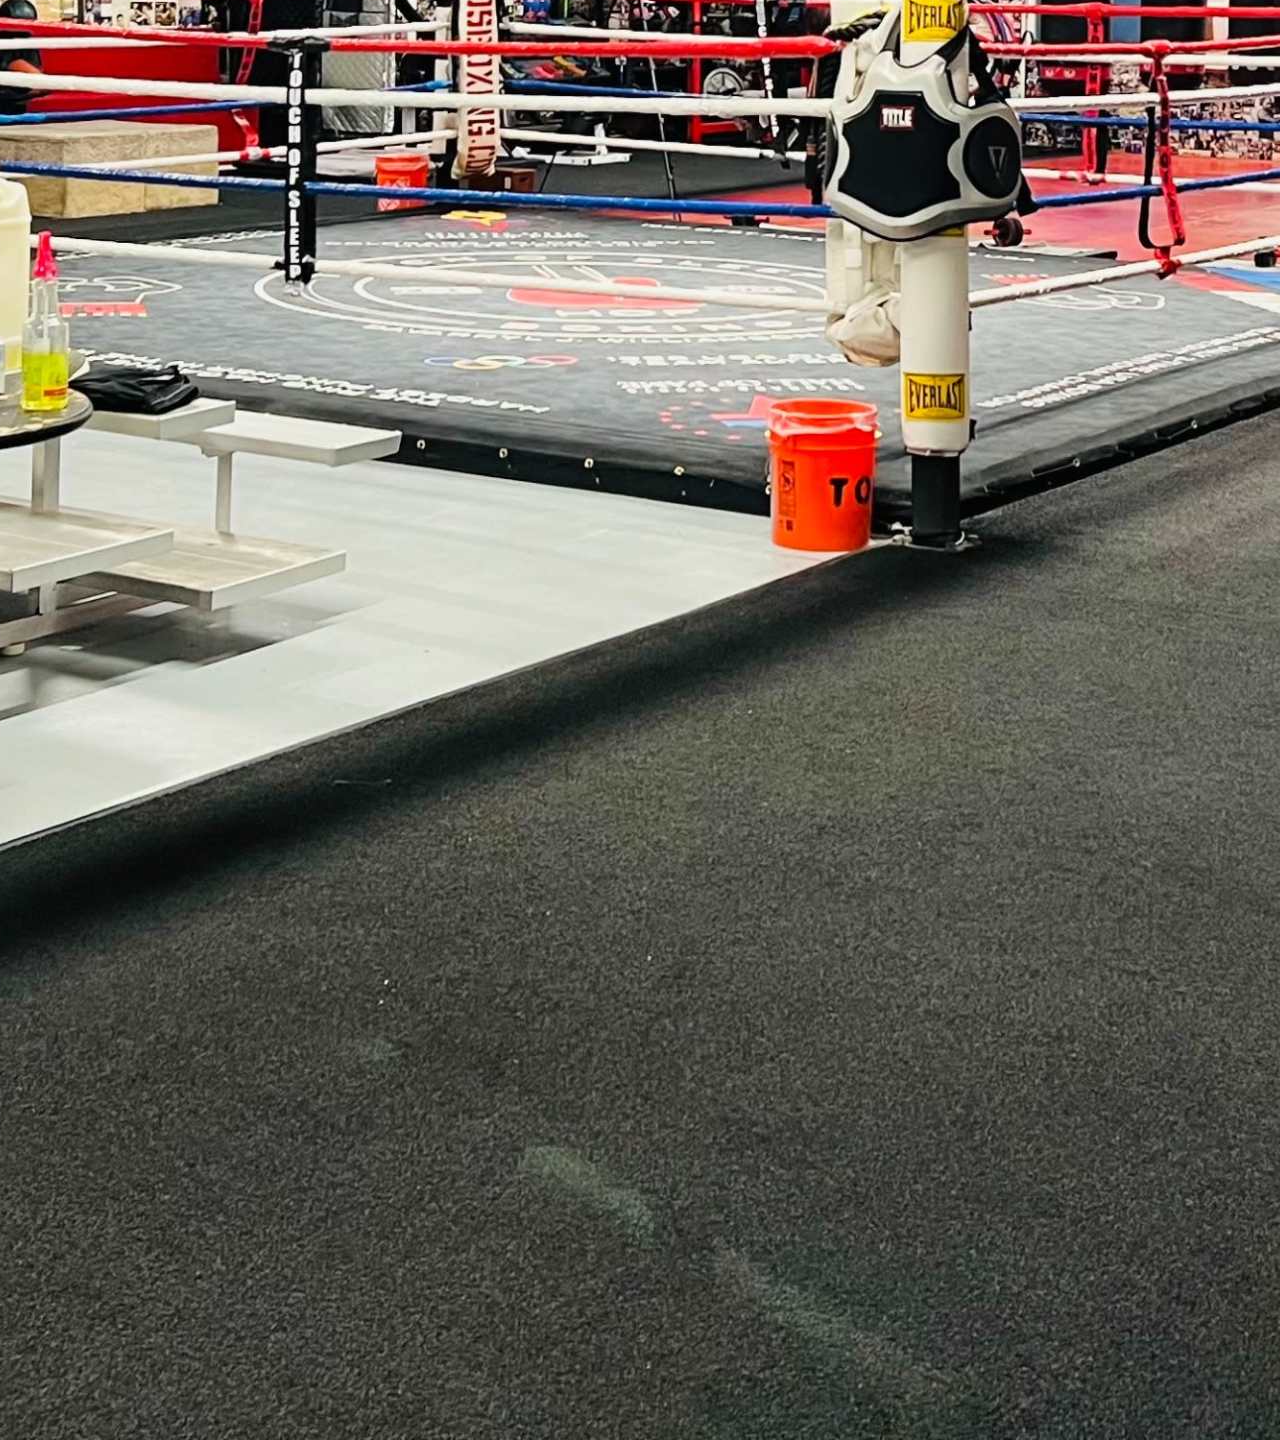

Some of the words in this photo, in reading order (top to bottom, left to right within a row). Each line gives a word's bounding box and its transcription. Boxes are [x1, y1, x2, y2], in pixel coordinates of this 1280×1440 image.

[288, 51, 303, 144] TOUCH
[880, 107, 914, 129] TITLE
[288, 148, 302, 186] OF
[288, 190, 302, 279] SLEEP
[908, 378, 963, 414] EVERLAST
